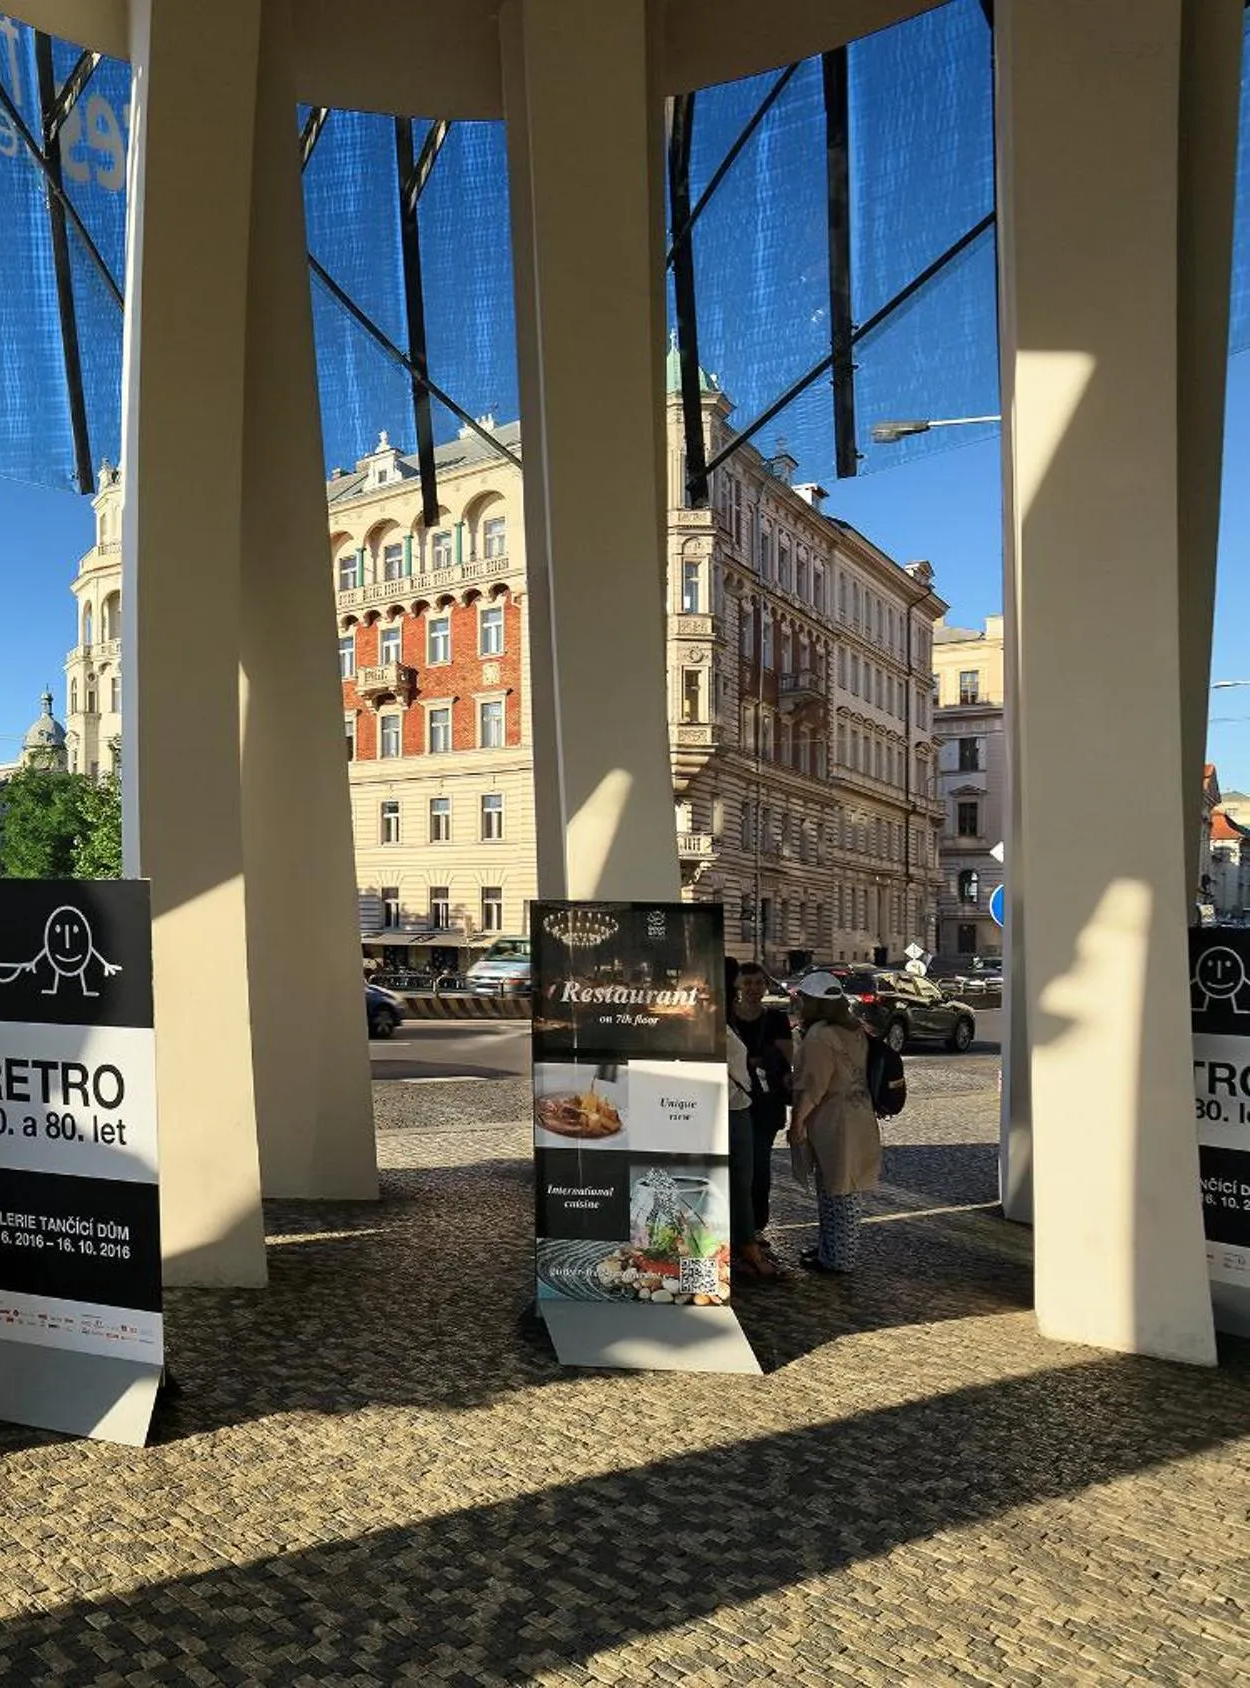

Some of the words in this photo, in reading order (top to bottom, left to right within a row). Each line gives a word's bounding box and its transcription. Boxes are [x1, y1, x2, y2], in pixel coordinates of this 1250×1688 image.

[560, 980, 700, 1006] Restaurant
[599, 1016, 613, 1024] on
[634, 1014, 660, 1026] floor
[660, 1097, 698, 1110] Unique
[23, 1116, 37, 1137] a
[46, 1112, 84, 1142] 80.
[94, 1115, 126, 1145] let
[547, 1184, 614, 1197] International
[564, 1200, 600, 1209] cuisine
[39, 1215, 94, 1236] TANČÍCÍ
[97, 1221, 130, 1241] DŮM
[1, 1231, 12, 1244] 6.
[15, 1232, 44, 1248] 2016
[57, 1237, 75, 1252] 16.
[78, 1240, 97, 1255] 10.
[100, 1243, 131, 1259] 2016
